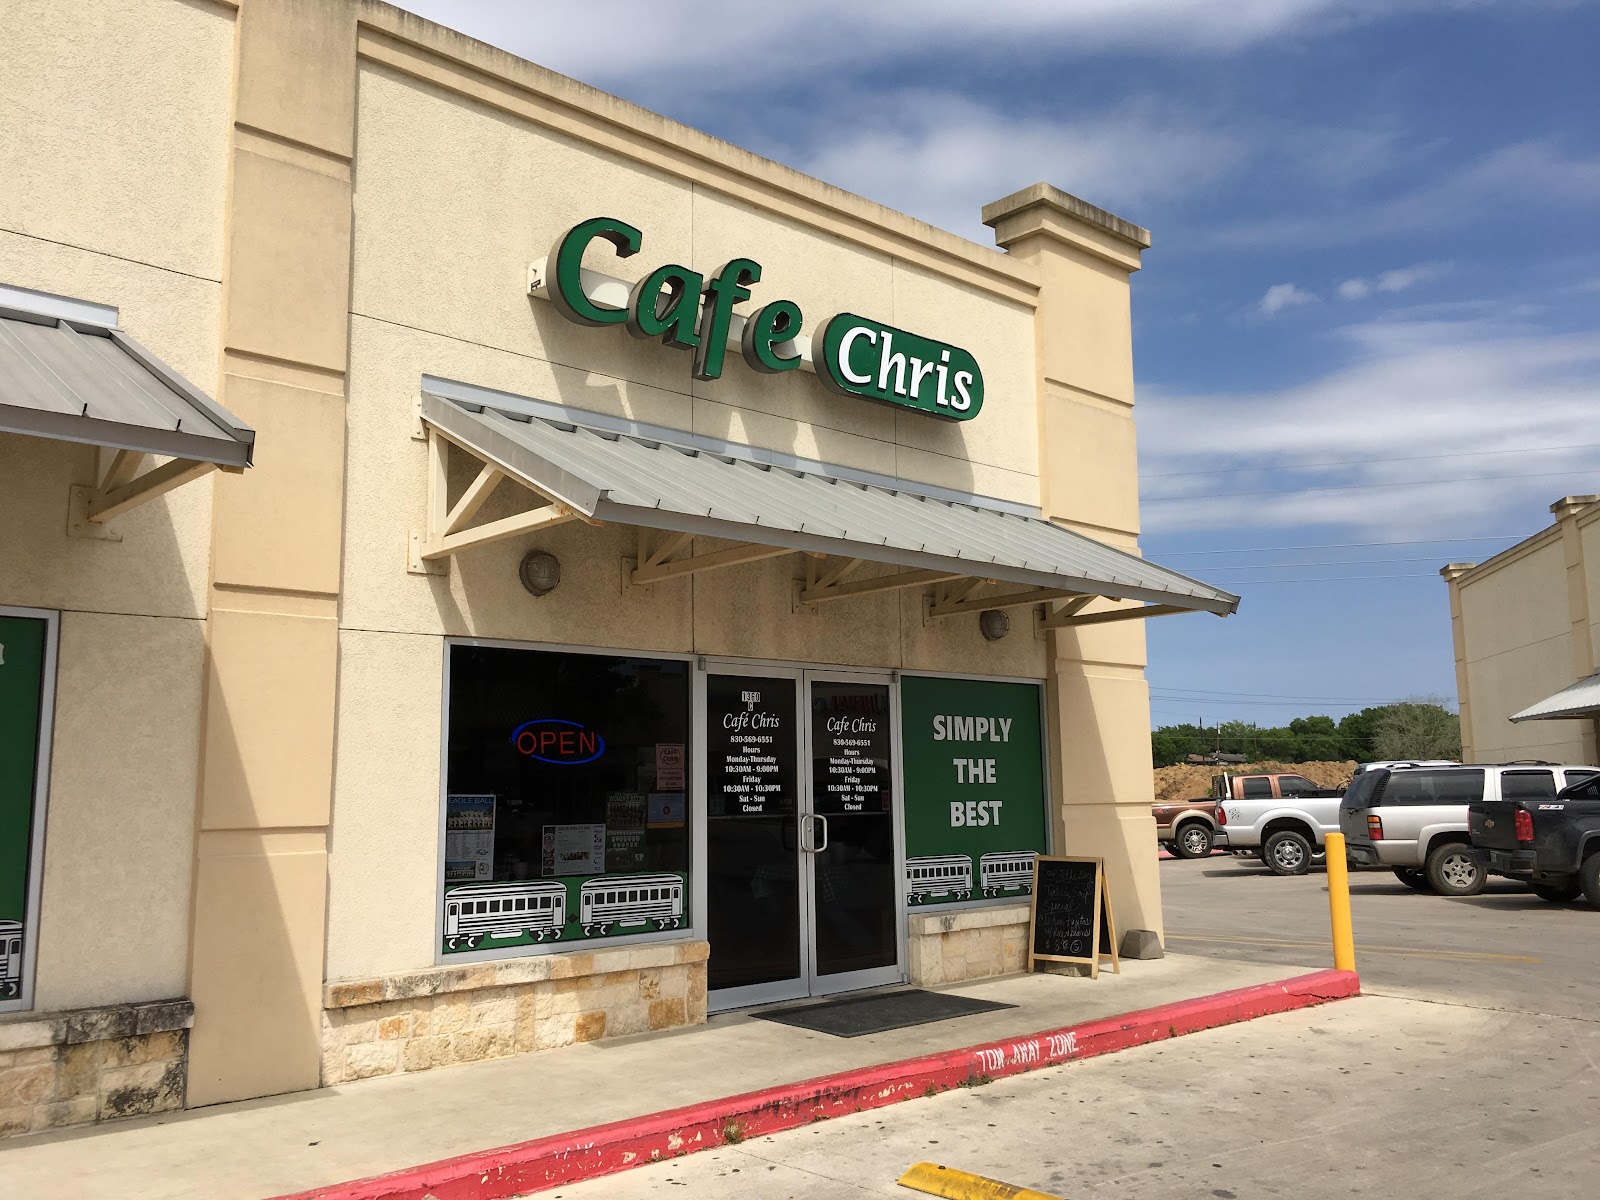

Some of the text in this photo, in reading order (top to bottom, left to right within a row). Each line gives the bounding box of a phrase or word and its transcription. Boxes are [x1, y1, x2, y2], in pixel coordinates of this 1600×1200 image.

[548, 217, 973, 412] Cafe Chris
[723, 711, 779, 732] Café Chris
[852, 717, 877, 733] Chris
[933, 714, 1012, 742] SIMPLY
[517, 731, 595, 755] OPEN
[730, 735, 773, 743] 830-569-6551
[833, 738, 871, 746] 830-569-6551
[726, 755, 776, 764] Monday-Thursday
[830, 758, 874, 766] Monday-Thursday
[725, 765, 752, 773] 10:30AM
[756, 765, 779, 773] 9:00PM
[953, 758, 997, 784] THE
[743, 775, 761, 784] Friday
[844, 776, 861, 785] Friday
[723, 785, 750, 793] 10:30AM
[755, 784, 781, 792] 10:30PM
[739, 795, 750, 803] Sat
[743, 804, 762, 812] Closed
[950, 800, 1003, 827] BEST
[976, 1032, 1080, 1072] TOW AWAY ZONE
